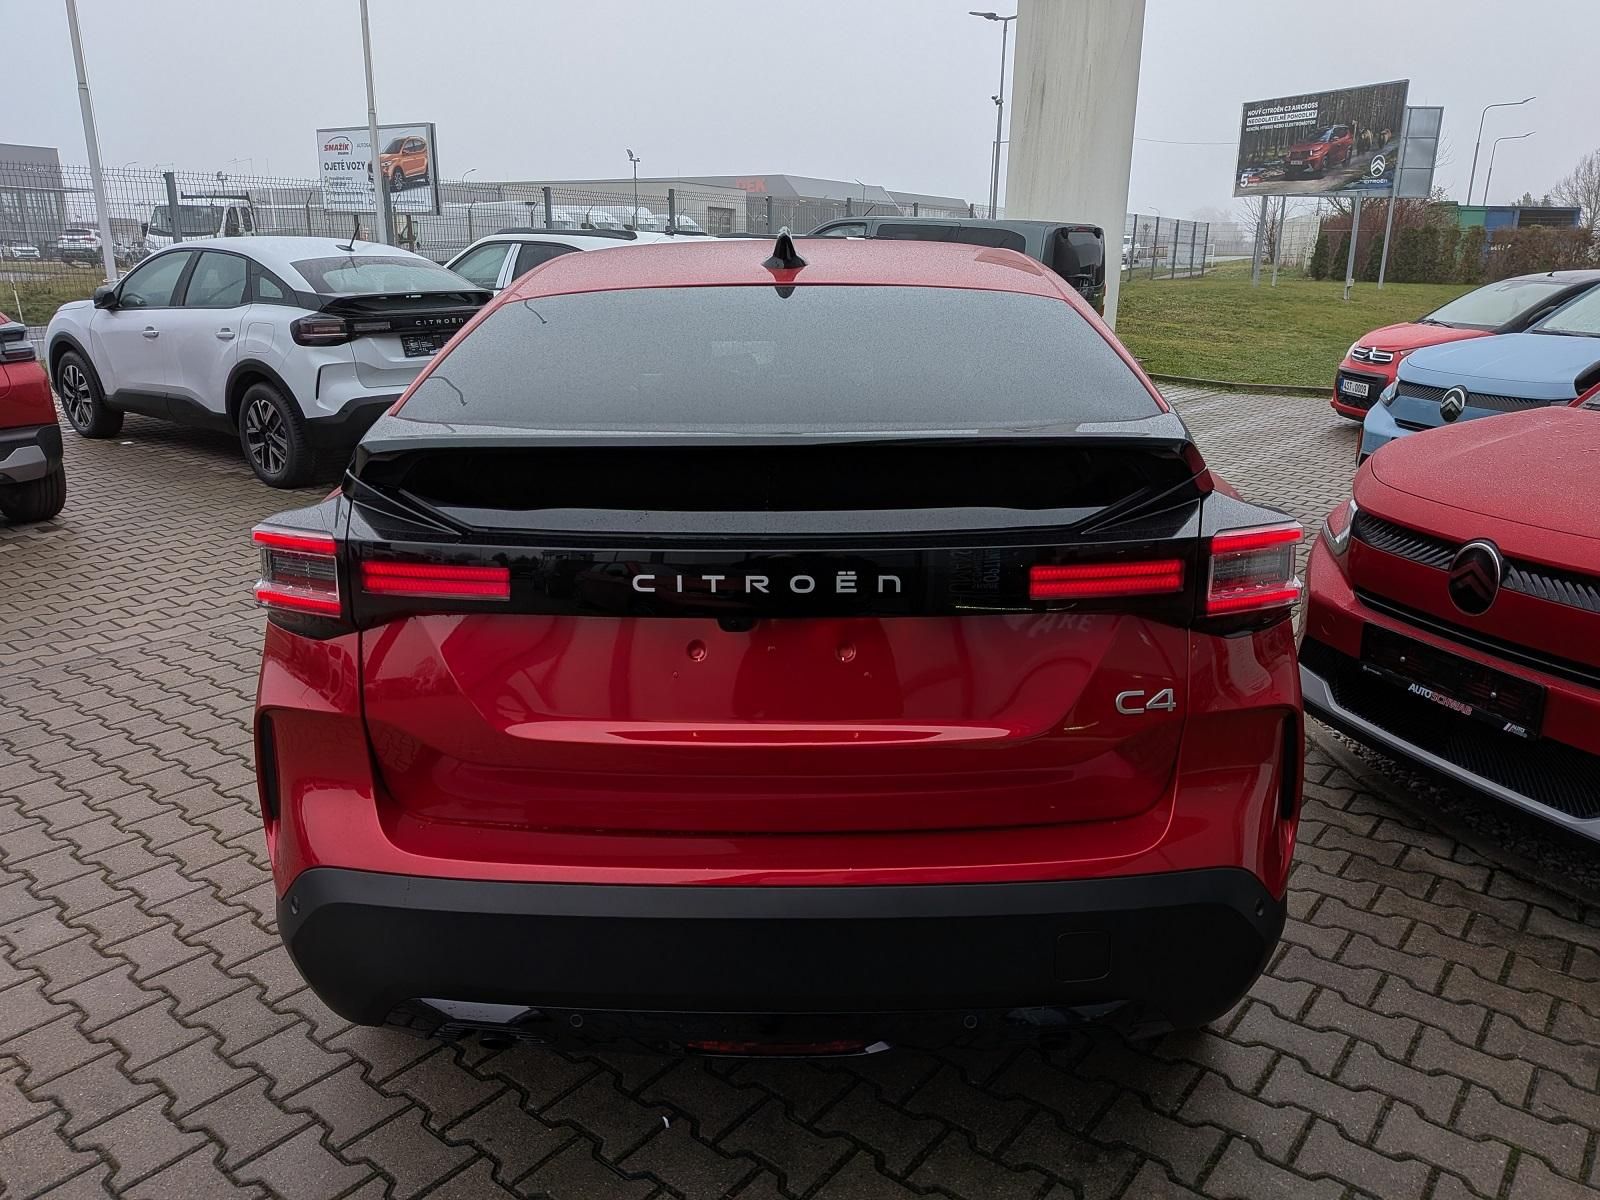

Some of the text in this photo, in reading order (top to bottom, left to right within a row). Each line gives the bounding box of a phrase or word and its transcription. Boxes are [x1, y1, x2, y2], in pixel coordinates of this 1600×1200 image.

[1292, 102, 1318, 111] AIRCROSS
[324, 159, 365, 171] OJETÉ VOZY
[631, 570, 901, 594] CITROËN
[1115, 688, 1177, 715] C4
